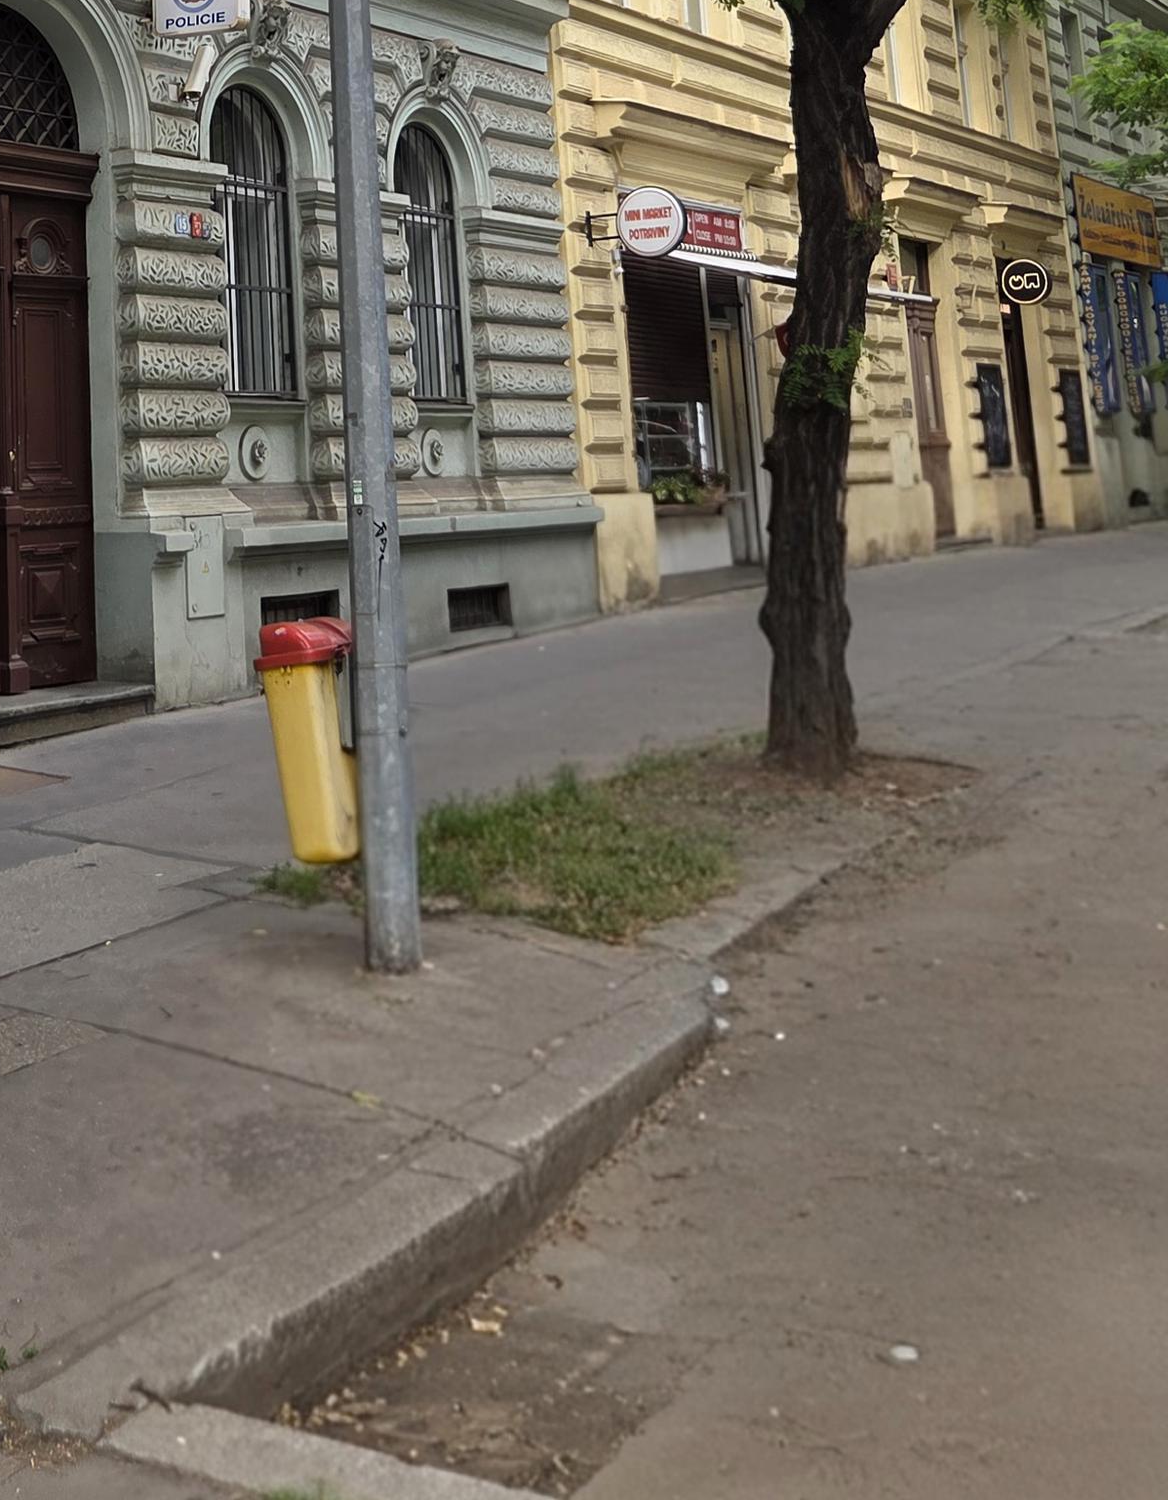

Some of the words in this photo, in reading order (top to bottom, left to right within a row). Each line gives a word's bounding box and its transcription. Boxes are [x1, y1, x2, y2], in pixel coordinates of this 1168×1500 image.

[165, 11, 226, 29] POLICIE
[624, 208, 641, 221] MINI
[642, 206, 672, 220] MARKET
[695, 212, 709, 224] OPEN
[629, 226, 670, 240] POTRAVINY
[695, 229, 712, 242] CLOSE
